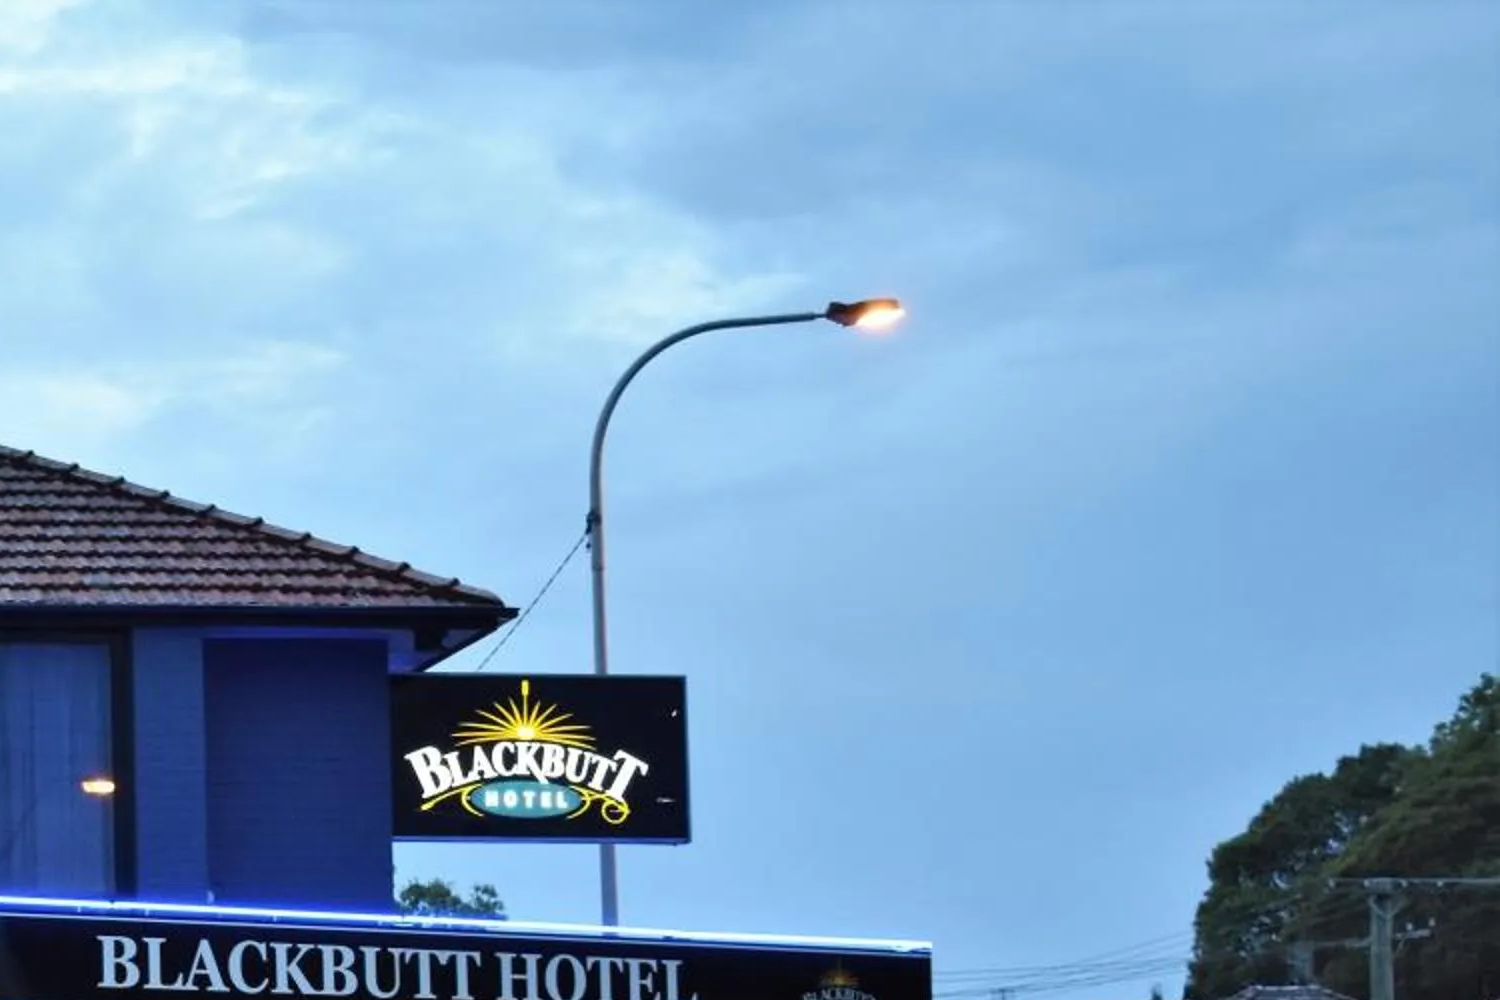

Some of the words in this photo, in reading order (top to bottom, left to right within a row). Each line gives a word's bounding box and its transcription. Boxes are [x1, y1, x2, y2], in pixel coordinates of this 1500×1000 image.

[404, 741, 649, 802] BLACKBUTT
[483, 789, 569, 809] HOTEL
[97, 935, 482, 1000] BLACKBUTT
